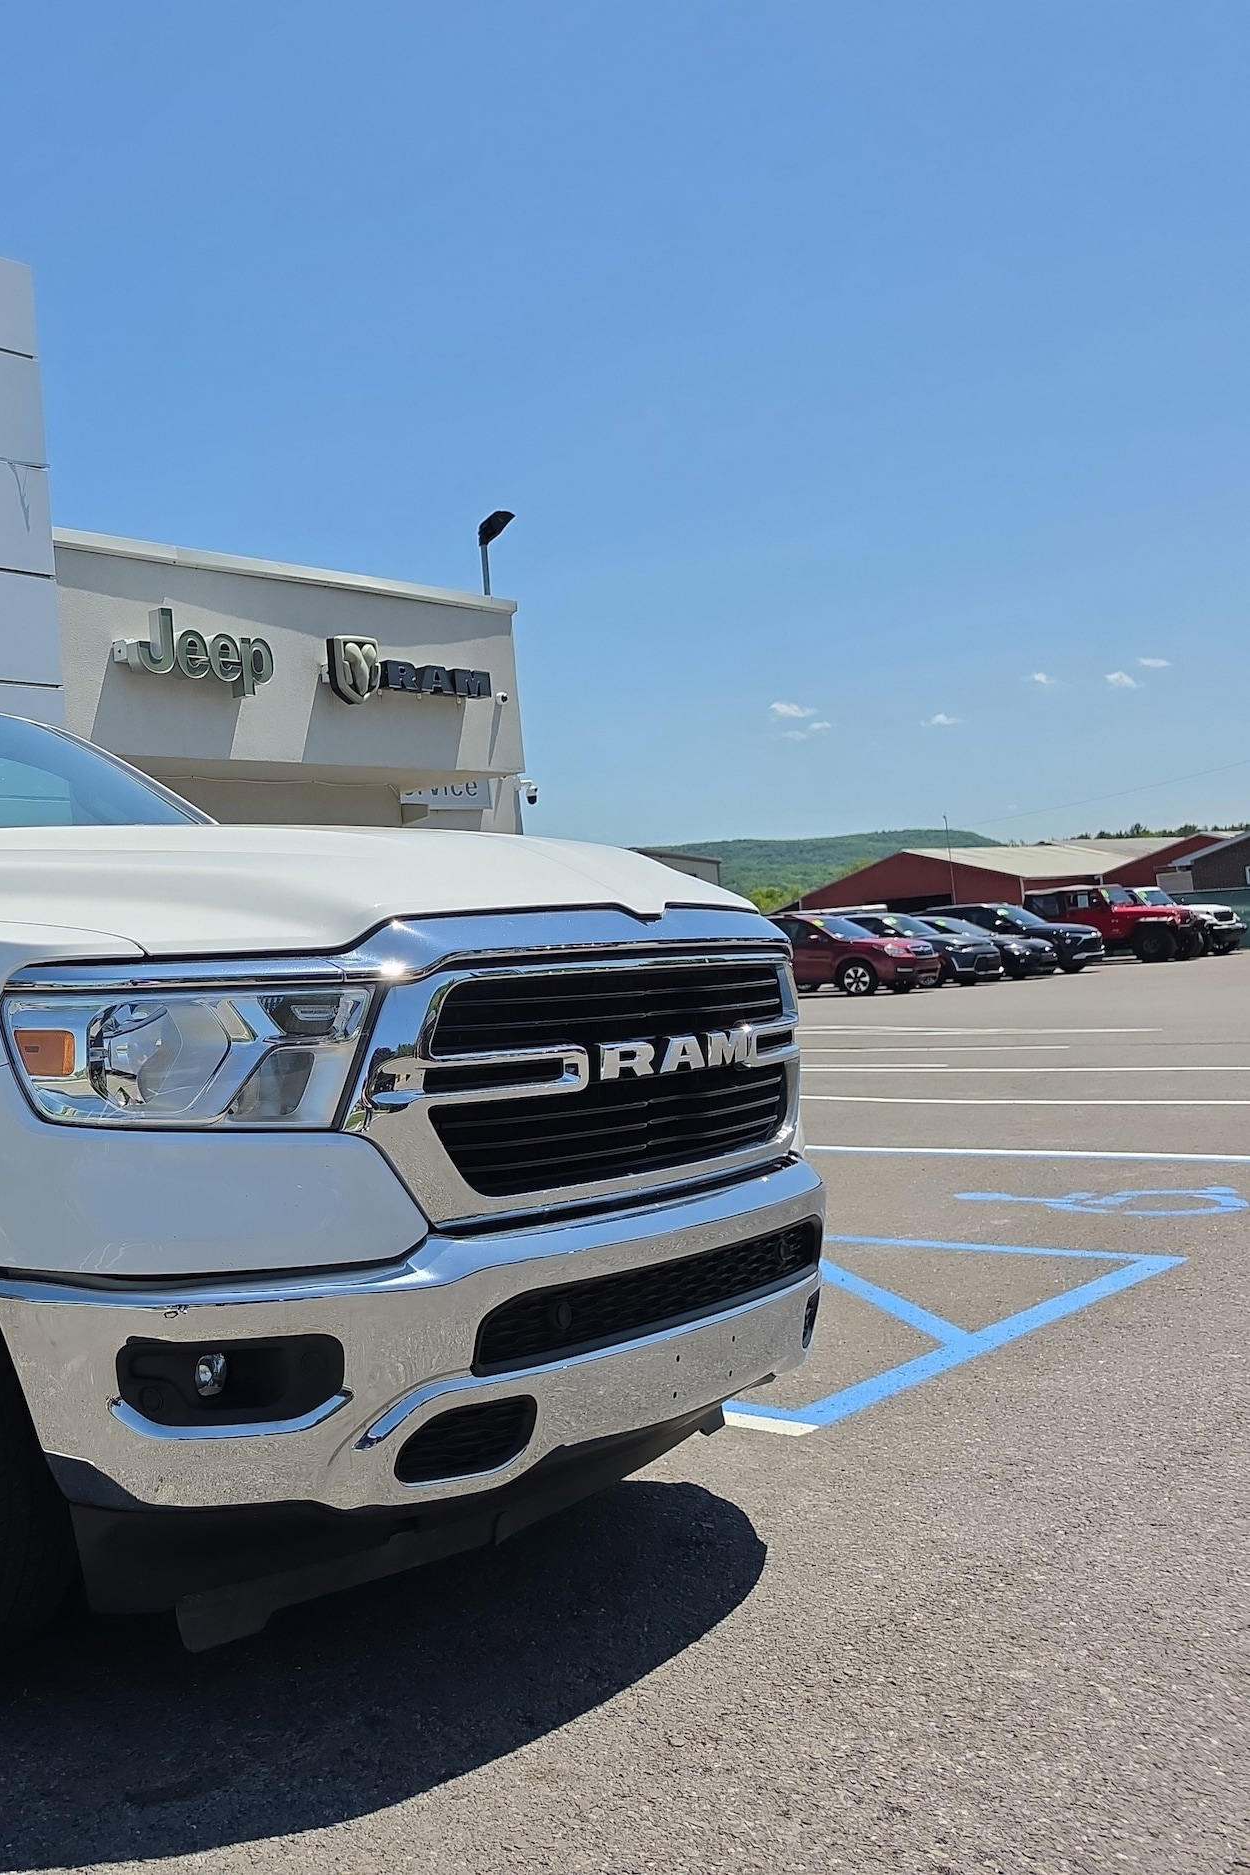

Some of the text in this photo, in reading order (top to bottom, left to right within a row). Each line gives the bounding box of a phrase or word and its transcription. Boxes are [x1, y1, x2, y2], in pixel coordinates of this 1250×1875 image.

[130, 607, 274, 698] Jeep
[380, 659, 493, 699] RAM
[599, 1028, 751, 1080] RAM
